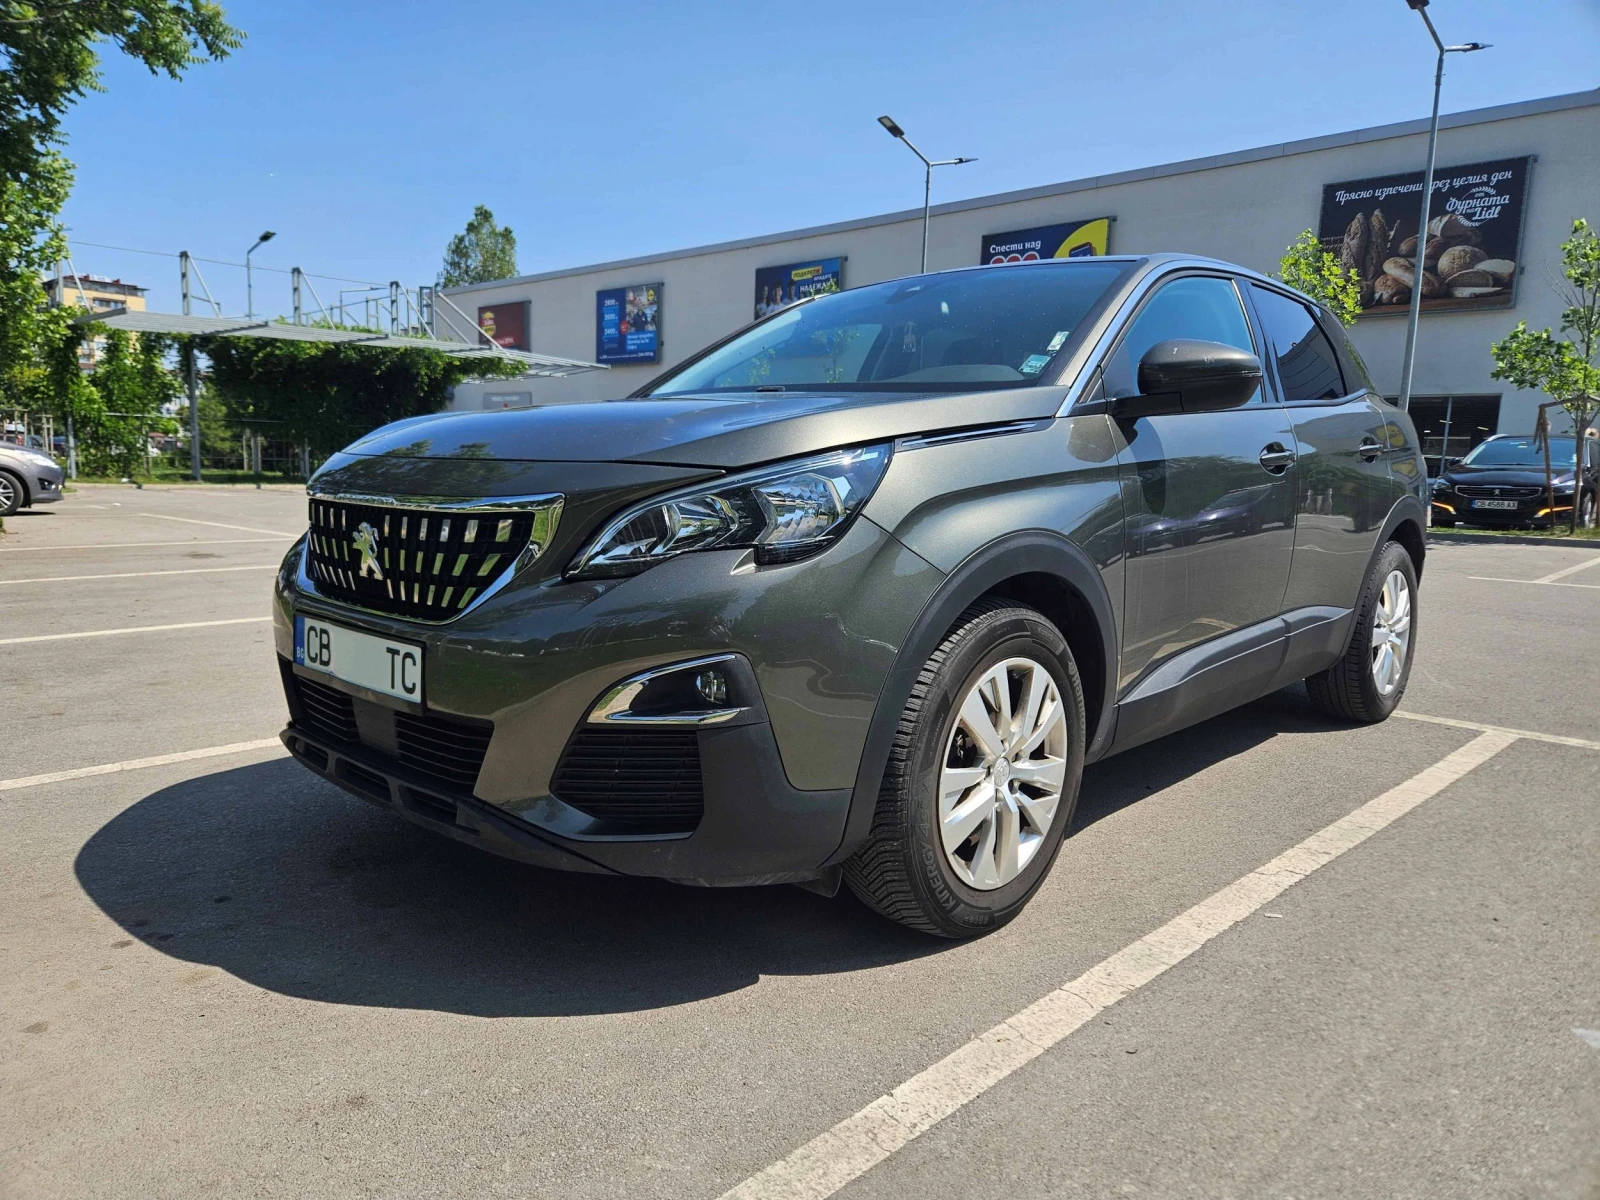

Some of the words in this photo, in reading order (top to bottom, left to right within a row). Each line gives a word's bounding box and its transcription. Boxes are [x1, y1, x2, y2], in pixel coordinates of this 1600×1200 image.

[1335, 189, 1373, 206] Прясно
[1374, 182, 1424, 201] изпечени
[1429, 178, 1451, 194] рез
[1452, 174, 1488, 189] целия
[1489, 169, 1513, 186] ден
[1446, 194, 1510, 215] Фурната
[1472, 205, 1503, 221] Lidl
[989, 244, 1024, 254] Спести
[1024, 240, 1042, 250] над
[297, 646, 304, 659] BG
[307, 625, 331, 667] CB
[386, 646, 417, 695] TC
